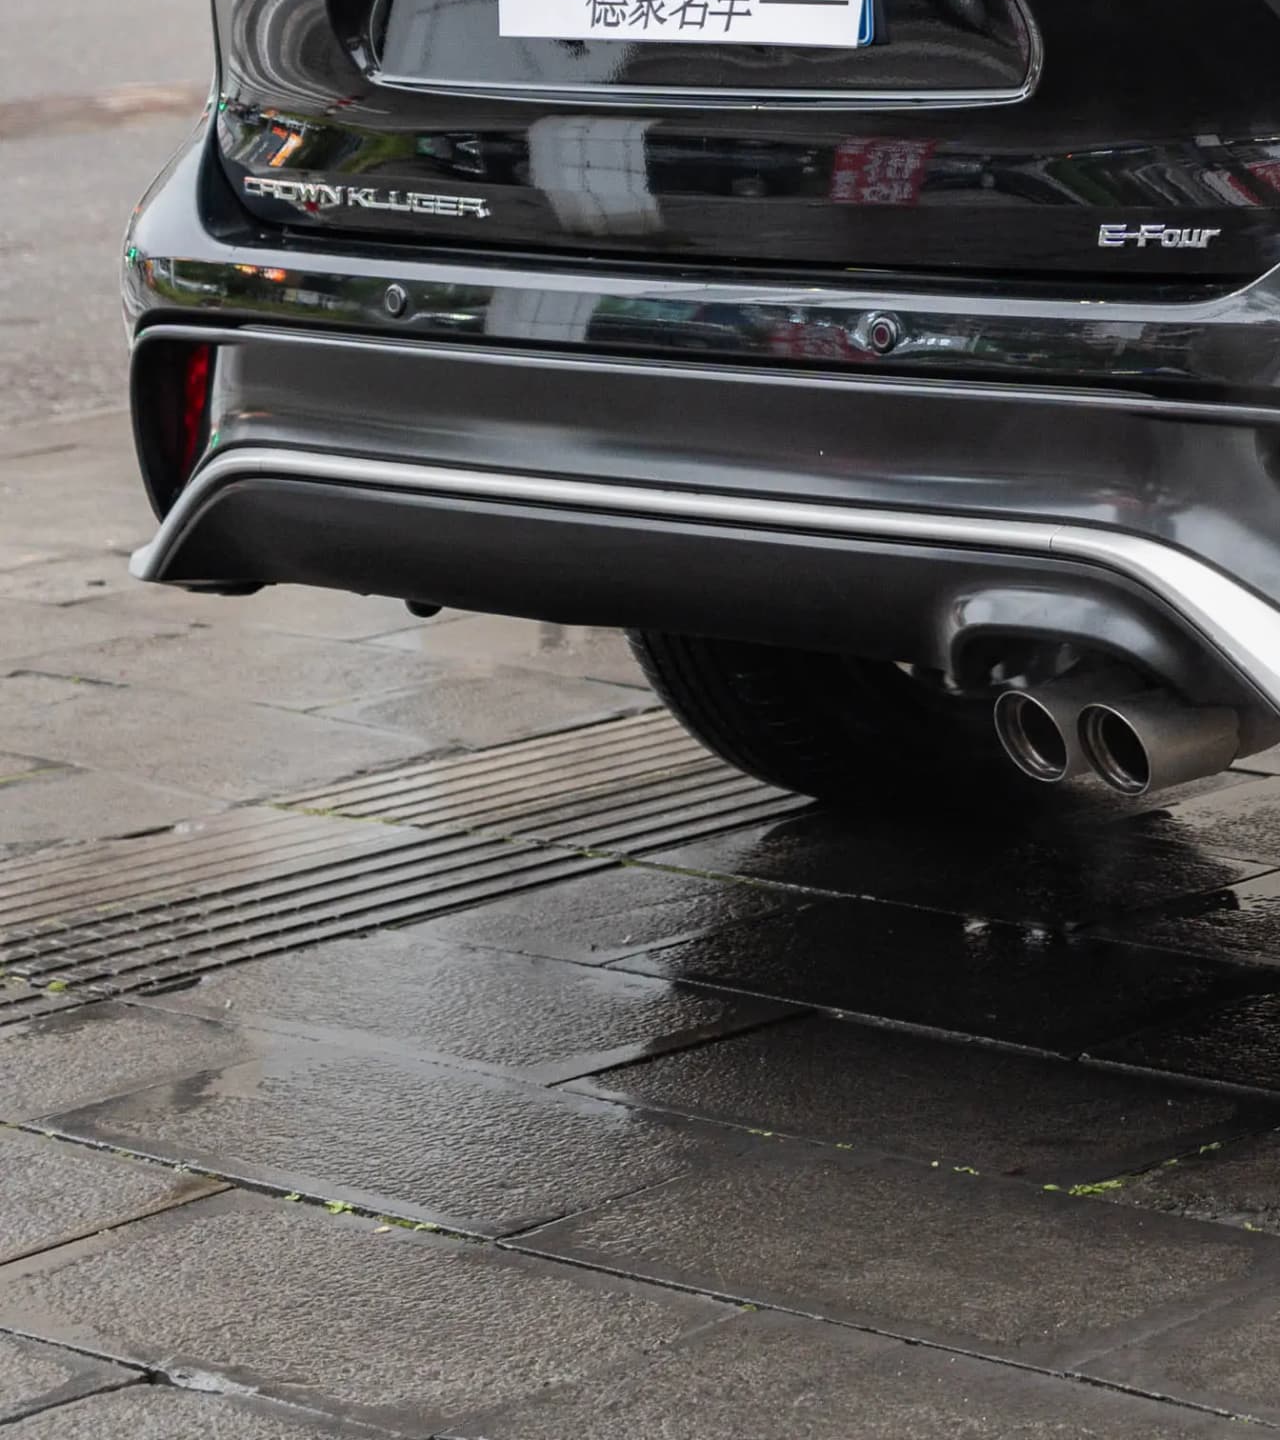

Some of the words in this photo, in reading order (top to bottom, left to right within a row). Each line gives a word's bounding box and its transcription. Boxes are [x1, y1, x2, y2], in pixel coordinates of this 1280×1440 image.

[244, 176, 345, 207] CROWN
[346, 186, 491, 218] KLUGER
[1098, 224, 1221, 248] E-Four
